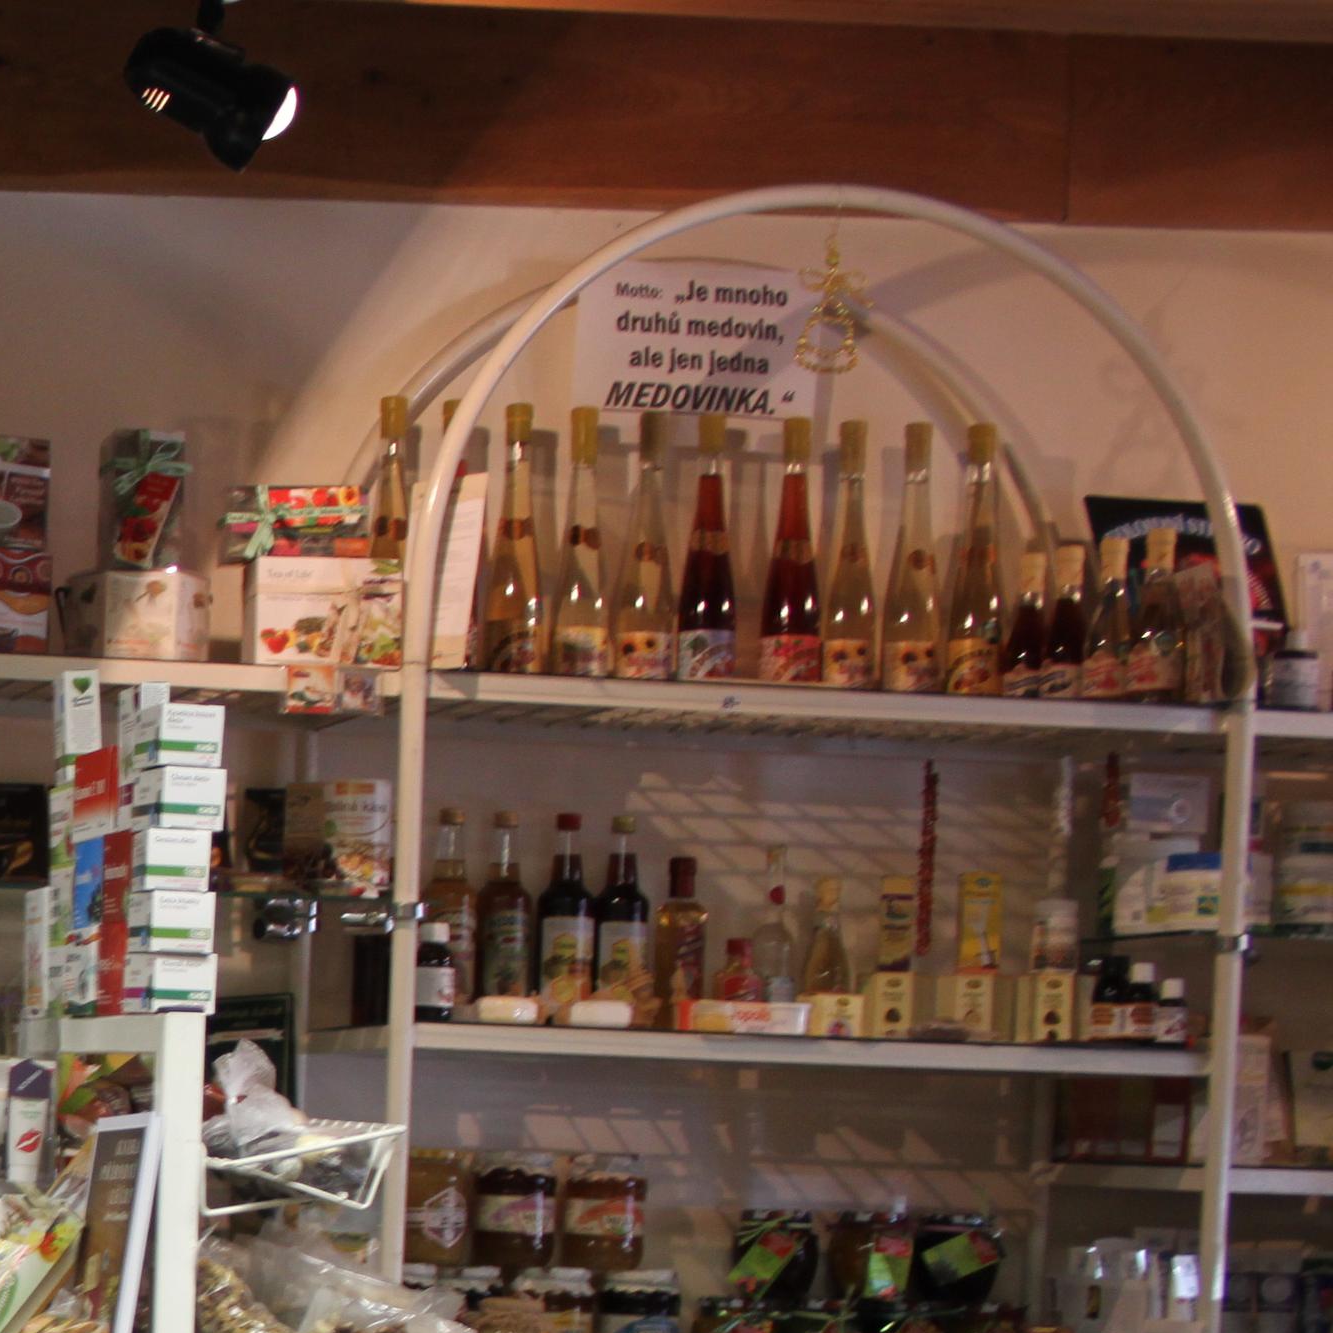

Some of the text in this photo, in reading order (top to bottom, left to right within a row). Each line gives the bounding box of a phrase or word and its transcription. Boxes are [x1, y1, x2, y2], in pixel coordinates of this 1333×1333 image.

[615, 281, 664, 300] Motto:
[715, 284, 788, 307] mnoho
[616, 310, 680, 336] druhů
[629, 347, 770, 376] ale jen jedna
